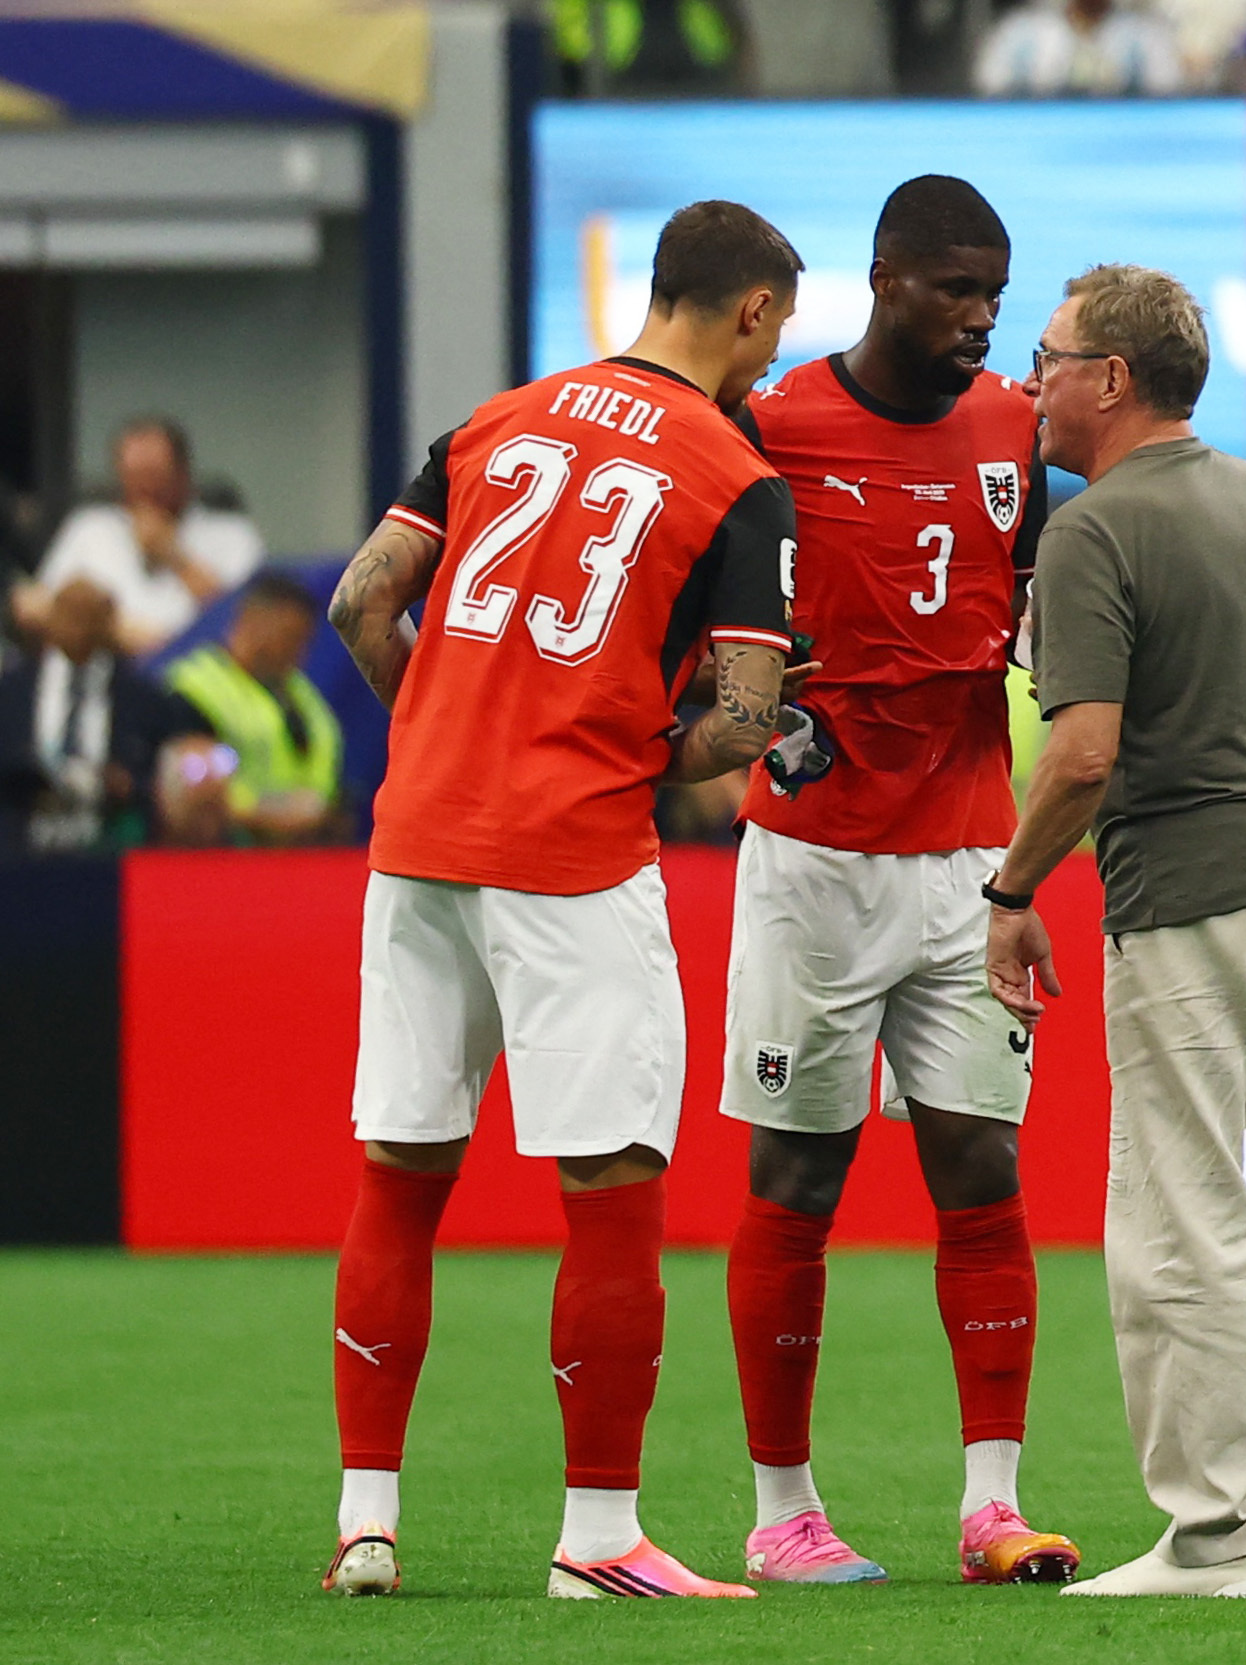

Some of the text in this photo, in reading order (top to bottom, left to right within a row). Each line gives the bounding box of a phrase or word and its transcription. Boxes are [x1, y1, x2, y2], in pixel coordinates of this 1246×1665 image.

[548, 382, 666, 445] FRIEDL
[444, 432, 674, 667] 23
[909, 524, 955, 615] 3
[964, 1316, 1028, 1331] ÖFB
